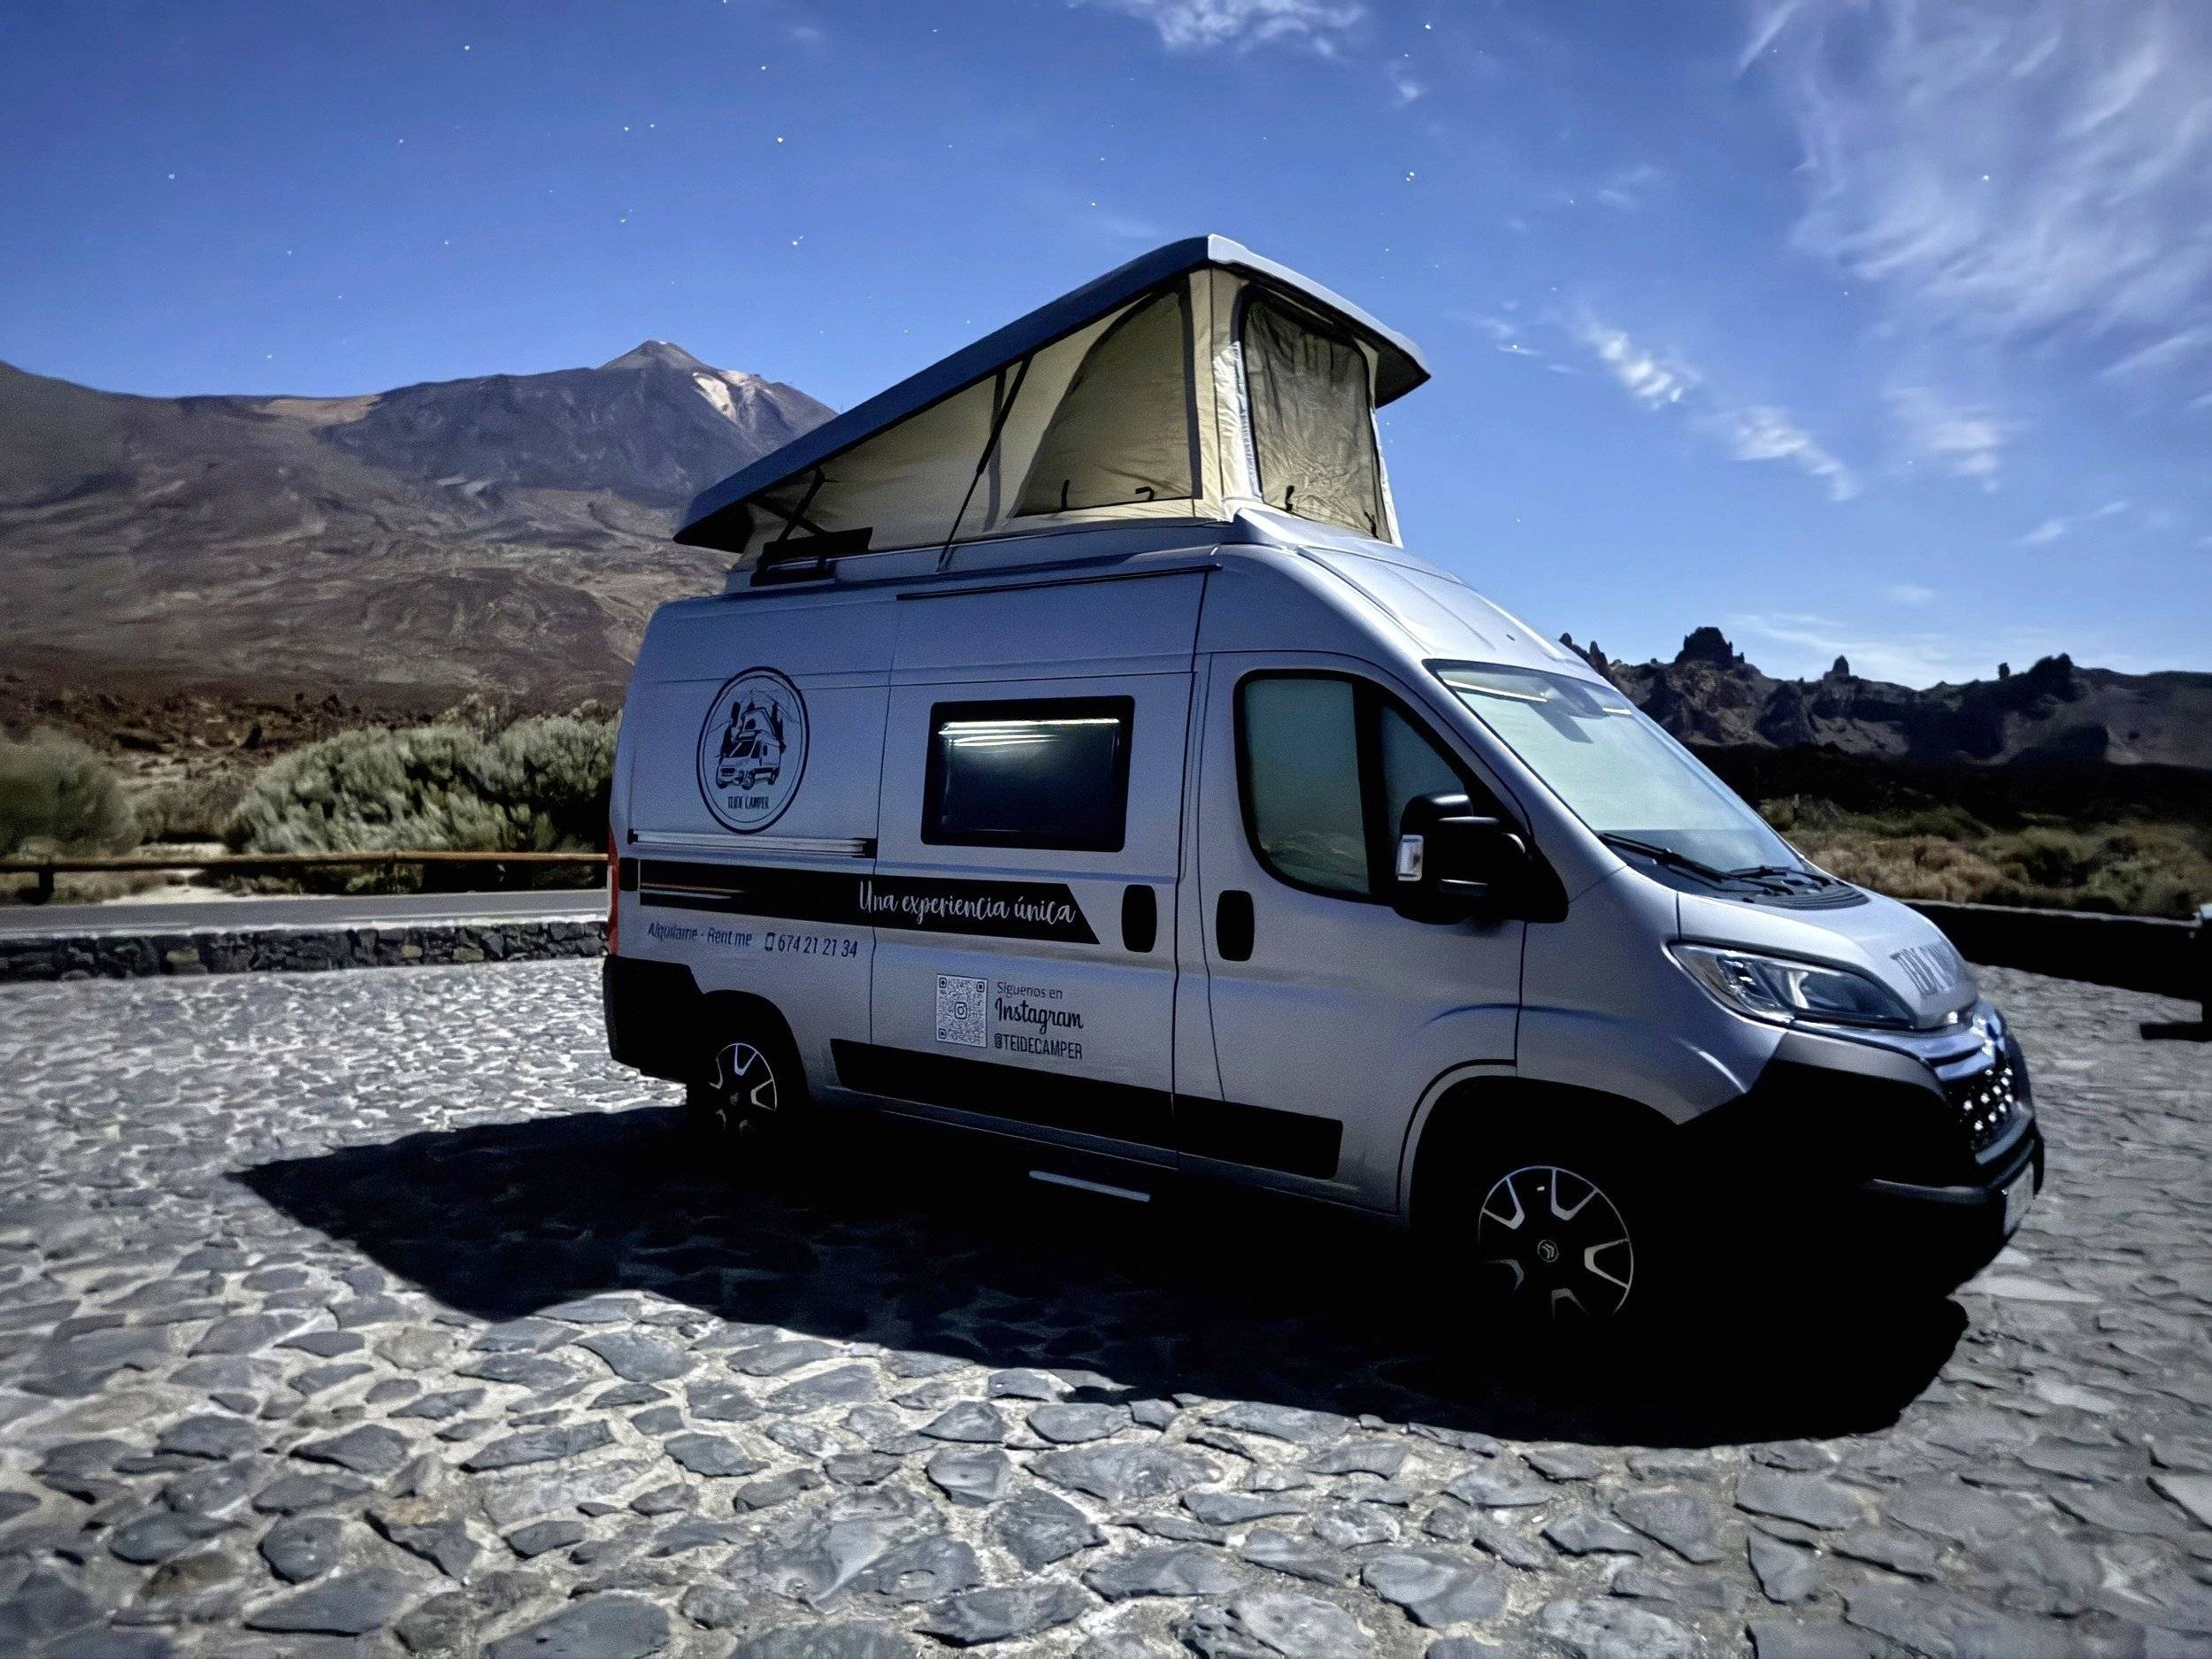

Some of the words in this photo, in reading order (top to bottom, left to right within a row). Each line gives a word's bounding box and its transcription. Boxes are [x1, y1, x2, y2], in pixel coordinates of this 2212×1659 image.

[859, 879, 898, 913] Una
[901, 894, 1010, 926] experiencia
[1014, 895, 1076, 925] única
[707, 926, 733, 945] Rent
[734, 933, 752, 946] me
[779, 934, 801, 952] 674
[803, 936, 818, 954] 21
[841, 939, 858, 957] 34
[1048, 989, 1063, 999] en
[995, 996, 1083, 1034] Instagram
[994, 1033, 1083, 1060] @TEIDECAMPER
